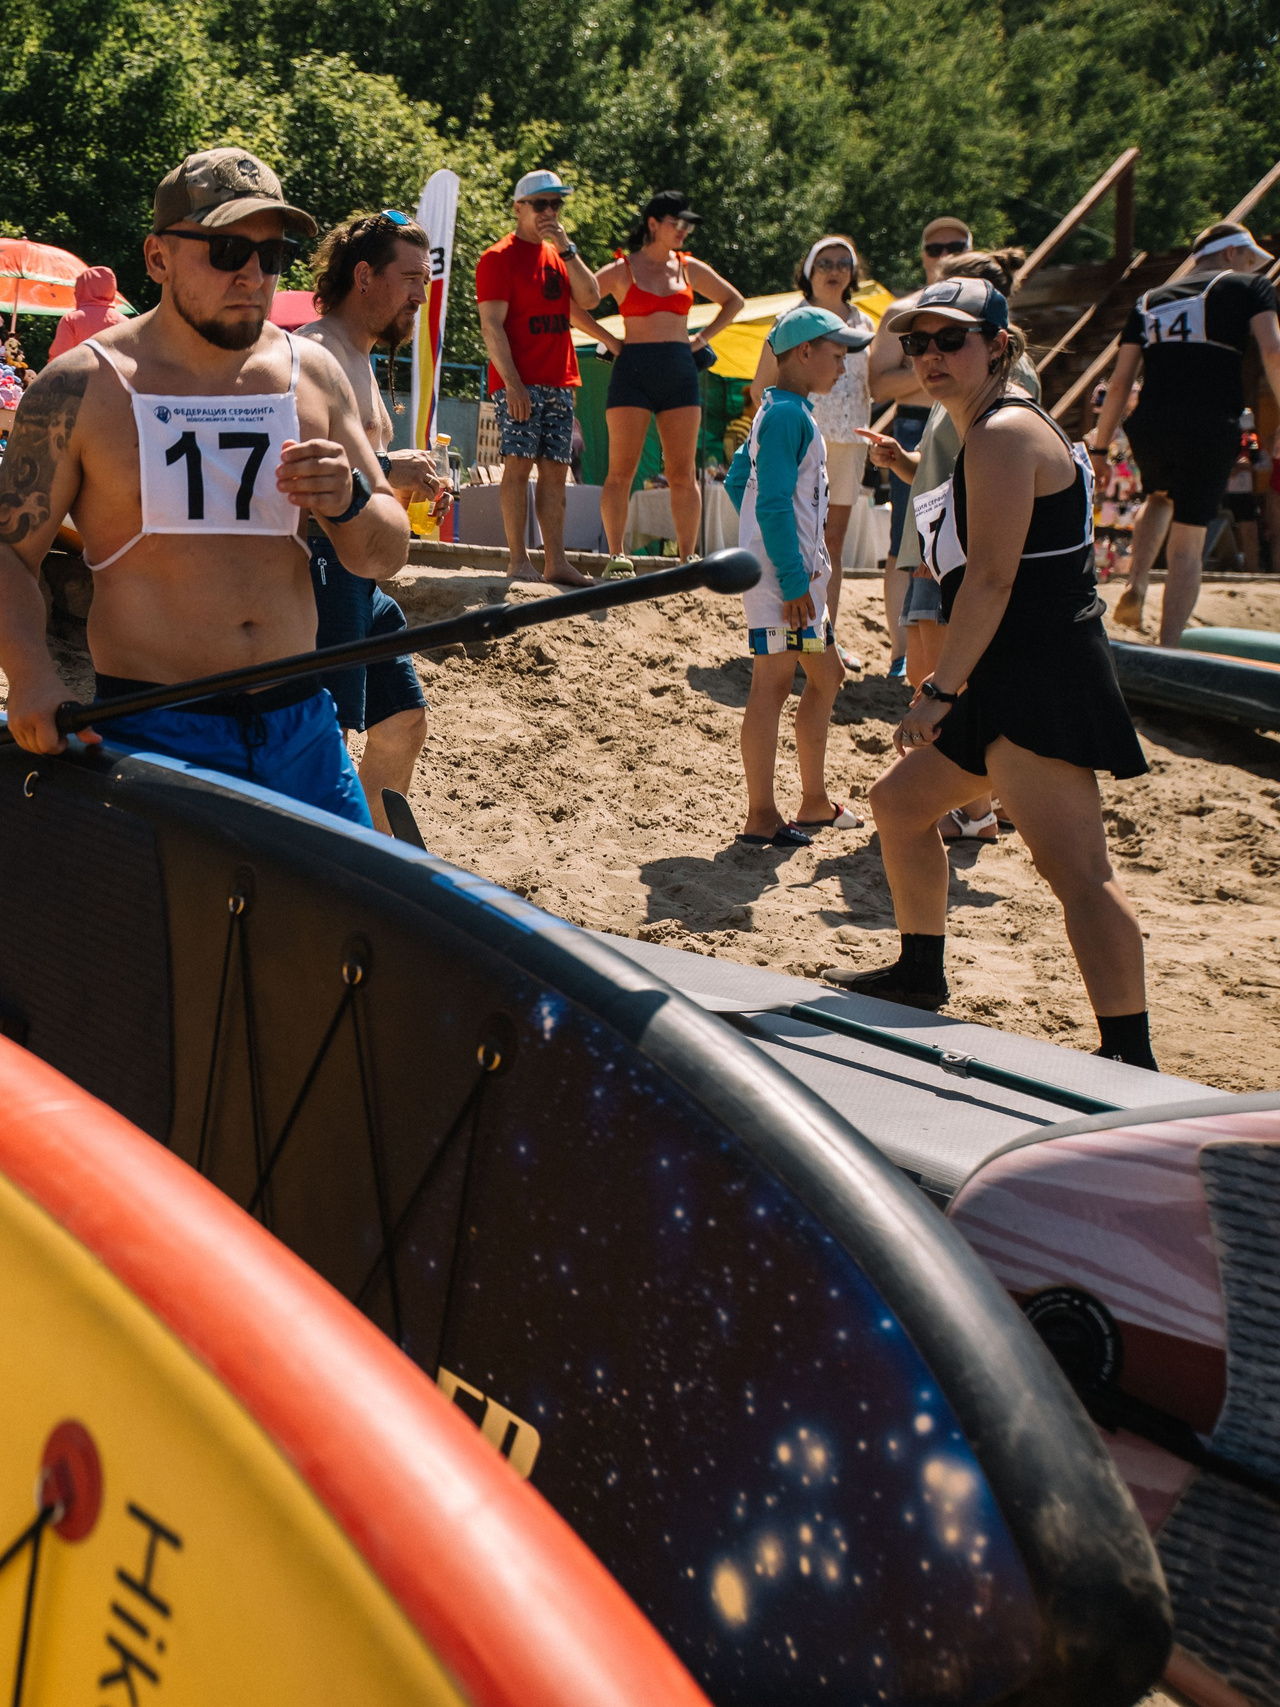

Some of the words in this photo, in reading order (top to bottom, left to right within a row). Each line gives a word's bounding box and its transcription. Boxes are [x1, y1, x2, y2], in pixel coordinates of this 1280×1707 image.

[1147, 310, 1193, 342] 14
[173, 406, 228, 417] ФЕДЕРАЦИЯ
[228, 405, 275, 416] СЕРФИНГА
[165, 430, 271, 521] 17
